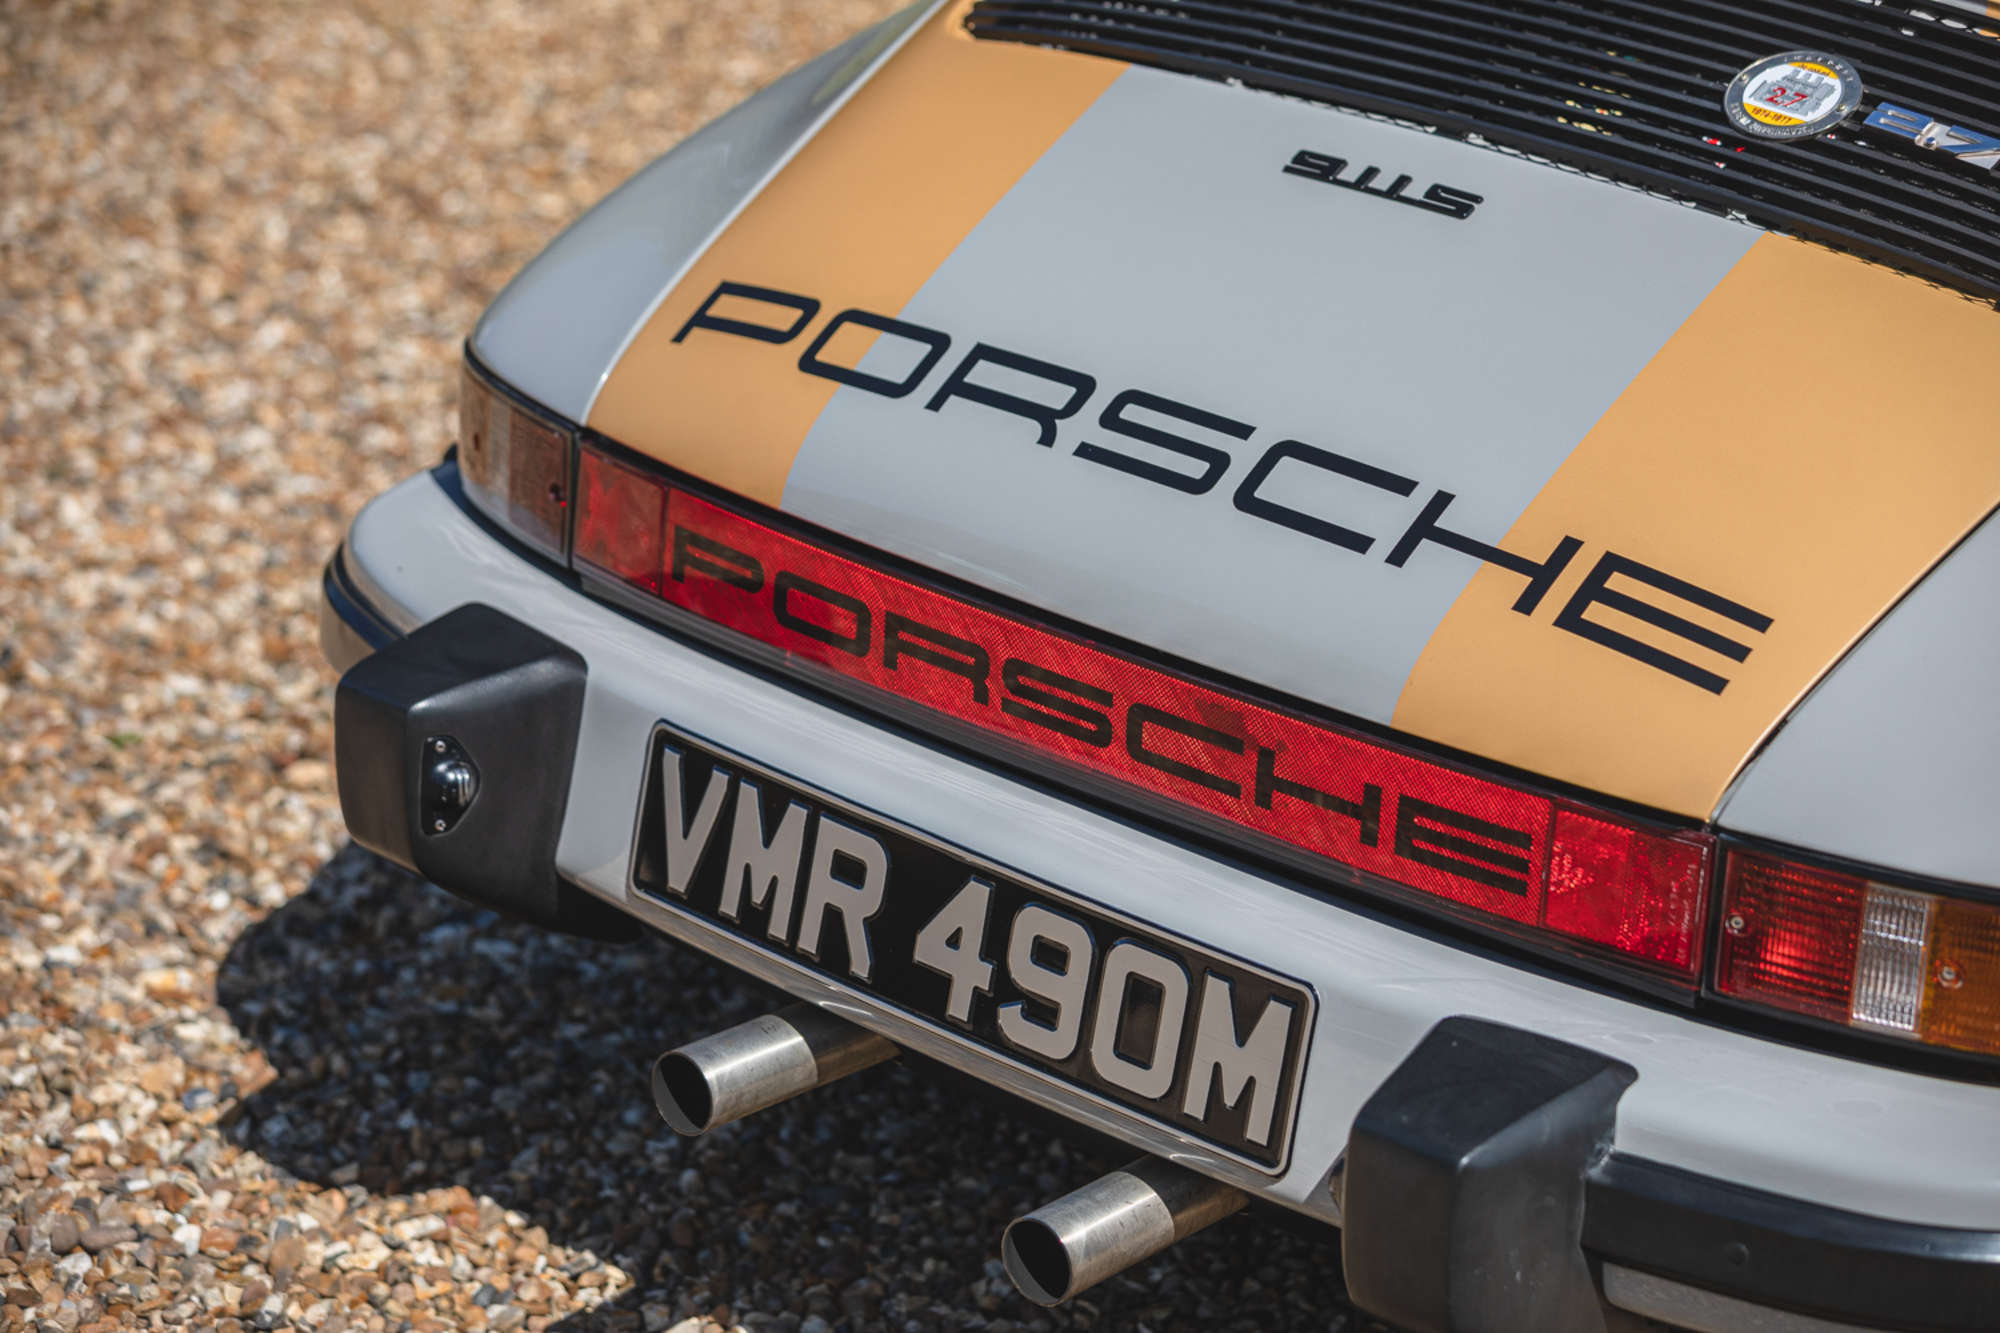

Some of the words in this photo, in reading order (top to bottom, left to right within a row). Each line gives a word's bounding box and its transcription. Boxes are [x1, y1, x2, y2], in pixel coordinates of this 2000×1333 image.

[672, 280, 1774, 695] PORSCHE
[672, 527, 1533, 896] PORSCHE
[661, 746, 891, 982] VMR
[912, 876, 1293, 1147] 490M
